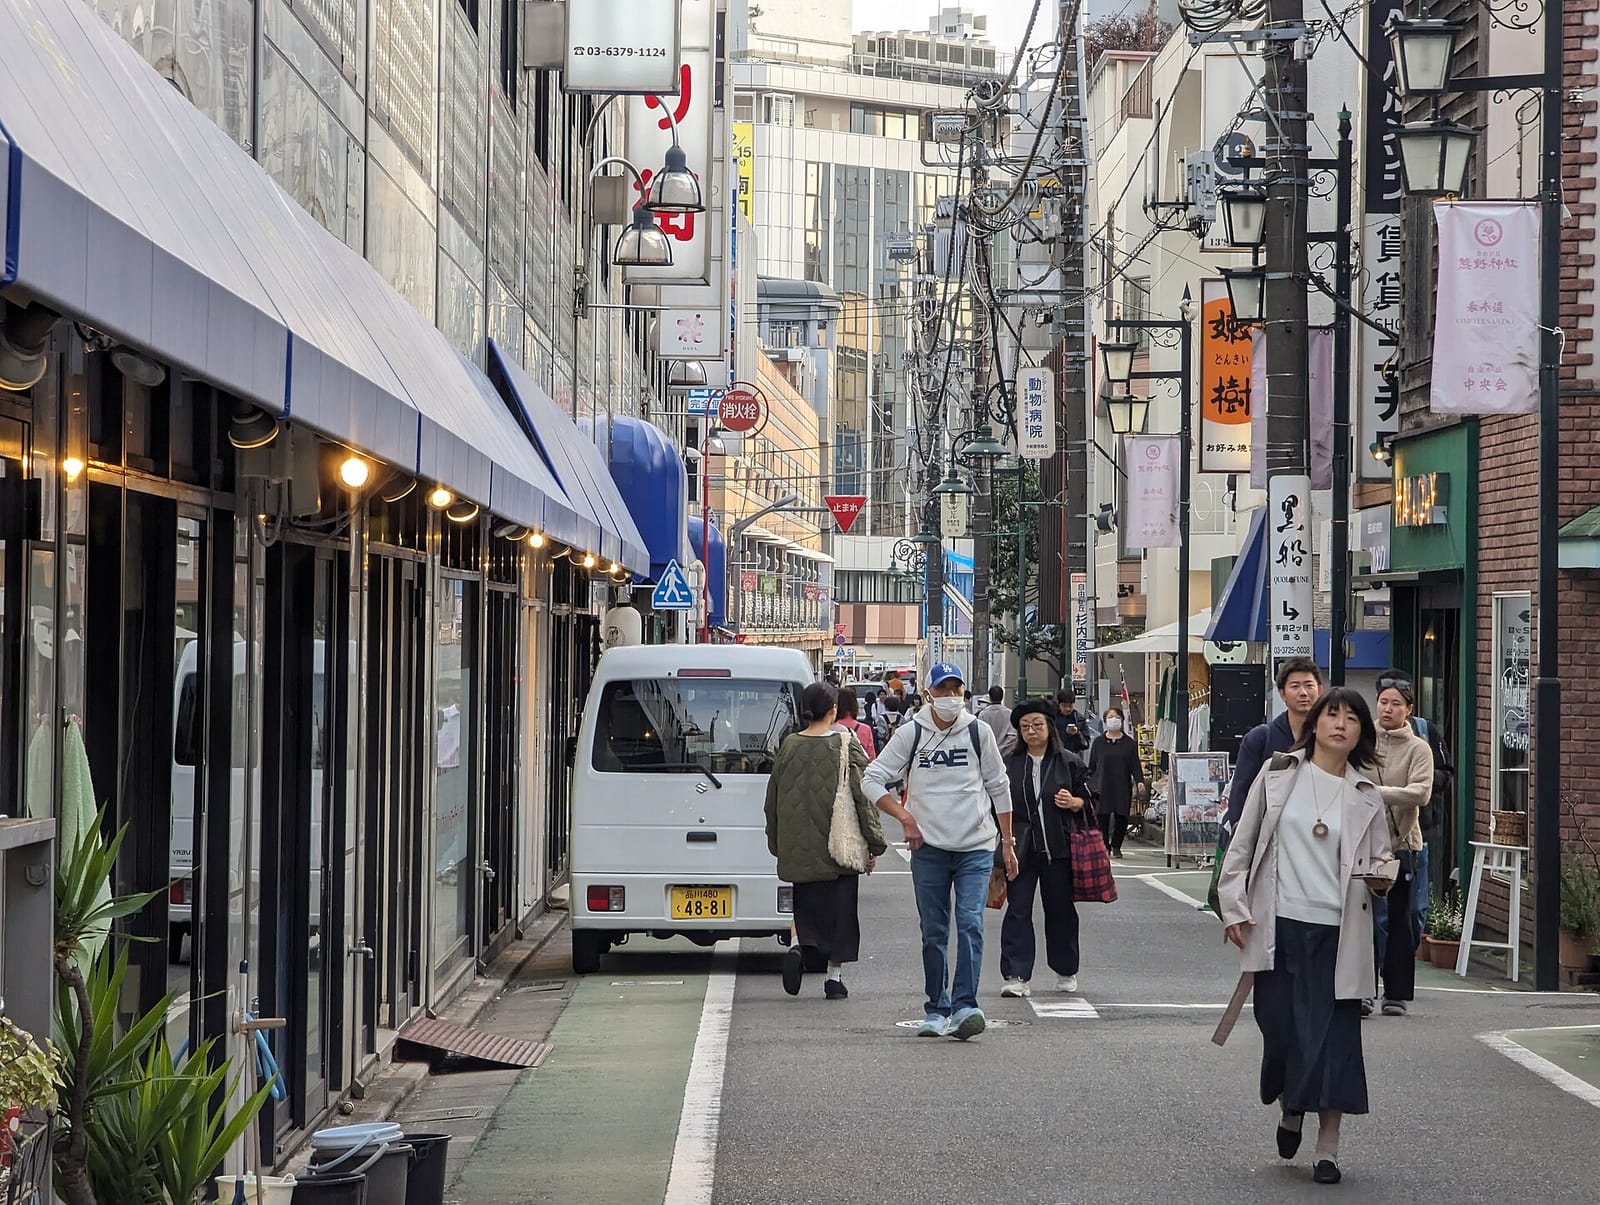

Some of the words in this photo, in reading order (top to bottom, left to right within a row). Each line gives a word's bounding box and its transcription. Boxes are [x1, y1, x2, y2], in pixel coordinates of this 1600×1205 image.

[587, 47, 666, 57] 03-6379-1124
[1463, 377, 1508, 392] 中央会
[722, 402, 757, 419] 消火栓
[1029, 377, 1043, 439] 動物病院
[832, 503, 858, 512] 止まれ
[1276, 494, 1307, 568] 黒船
[1076, 613, 1087, 663] 杉内医院
[1274, 646, 1310, 654] 03-3725-0038
[685, 890, 719, 899] 品川480
[685, 900, 726, 916] 48-81
